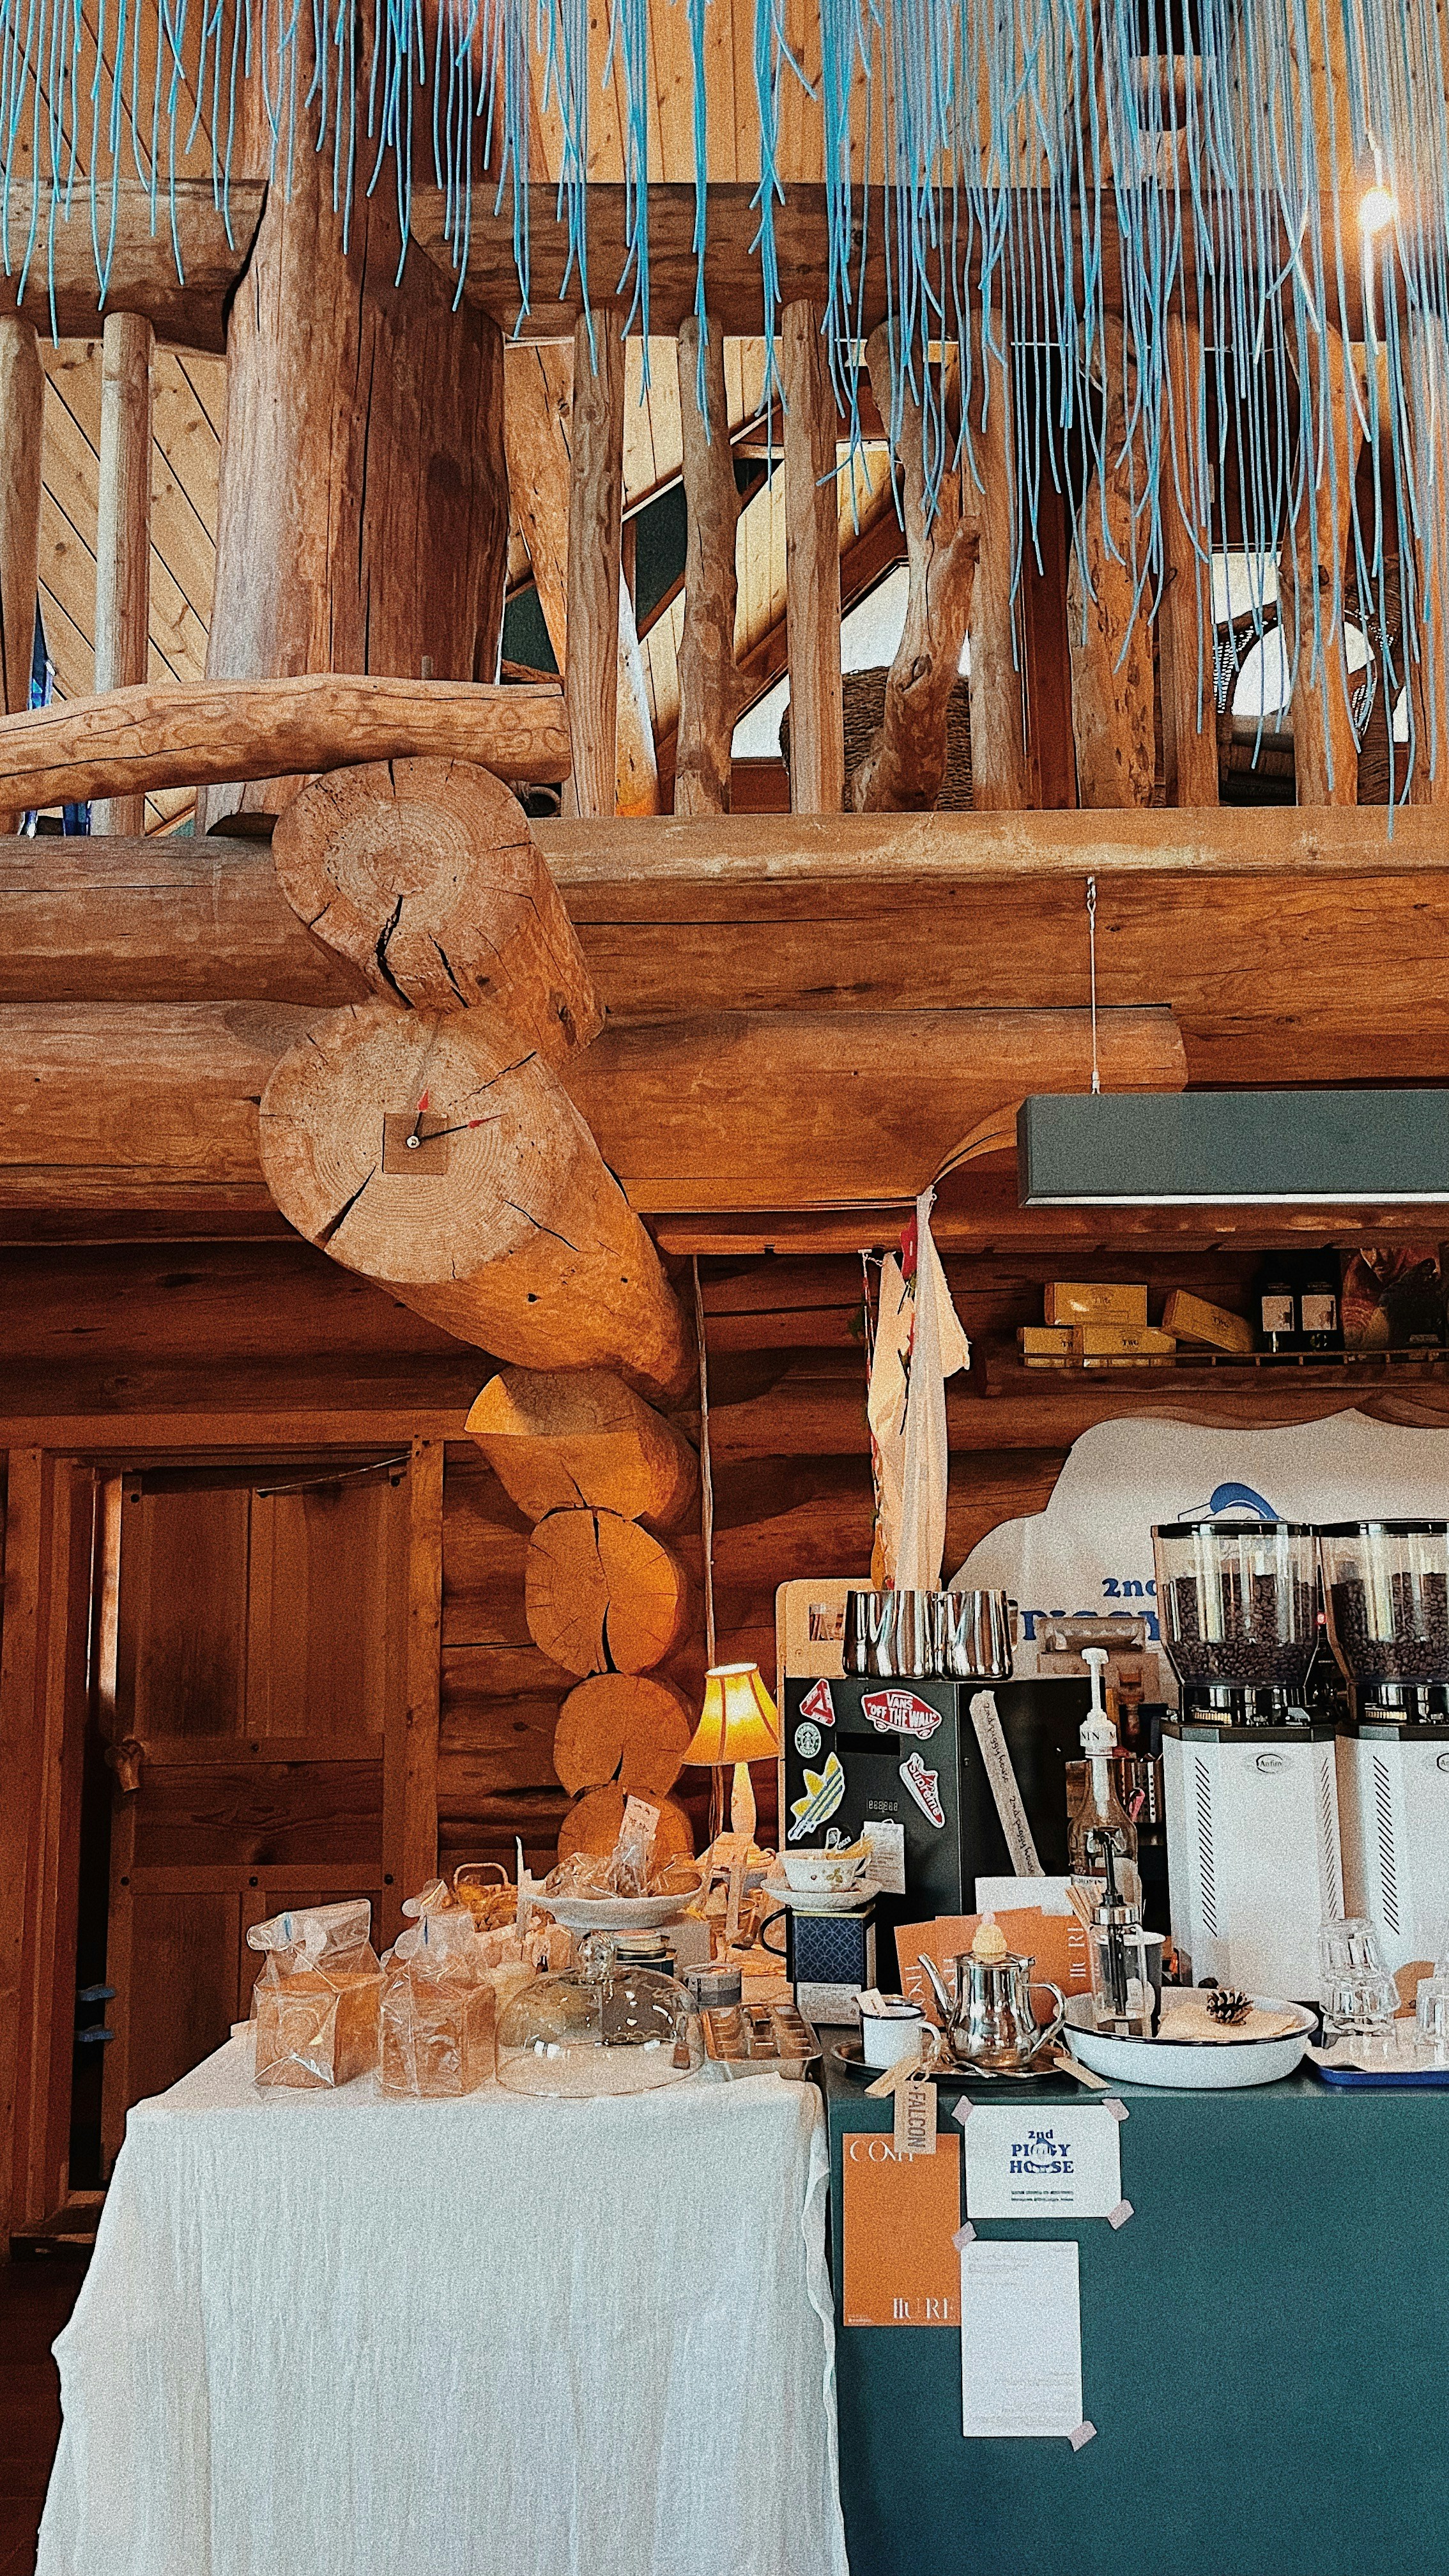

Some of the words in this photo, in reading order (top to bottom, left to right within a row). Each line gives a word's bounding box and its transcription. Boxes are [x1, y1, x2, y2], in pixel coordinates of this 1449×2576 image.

[886, 1693, 914, 1710] VANS
[889, 1707, 907, 1727] THE
[983, 1703, 994, 1724] 2nd
[908, 1764, 940, 1816] Supreme
[1009, 1795, 1020, 1815] 2nd
[908, 2092, 926, 2148] FALCON
[1028, 2129, 1054, 2139] 2nd
